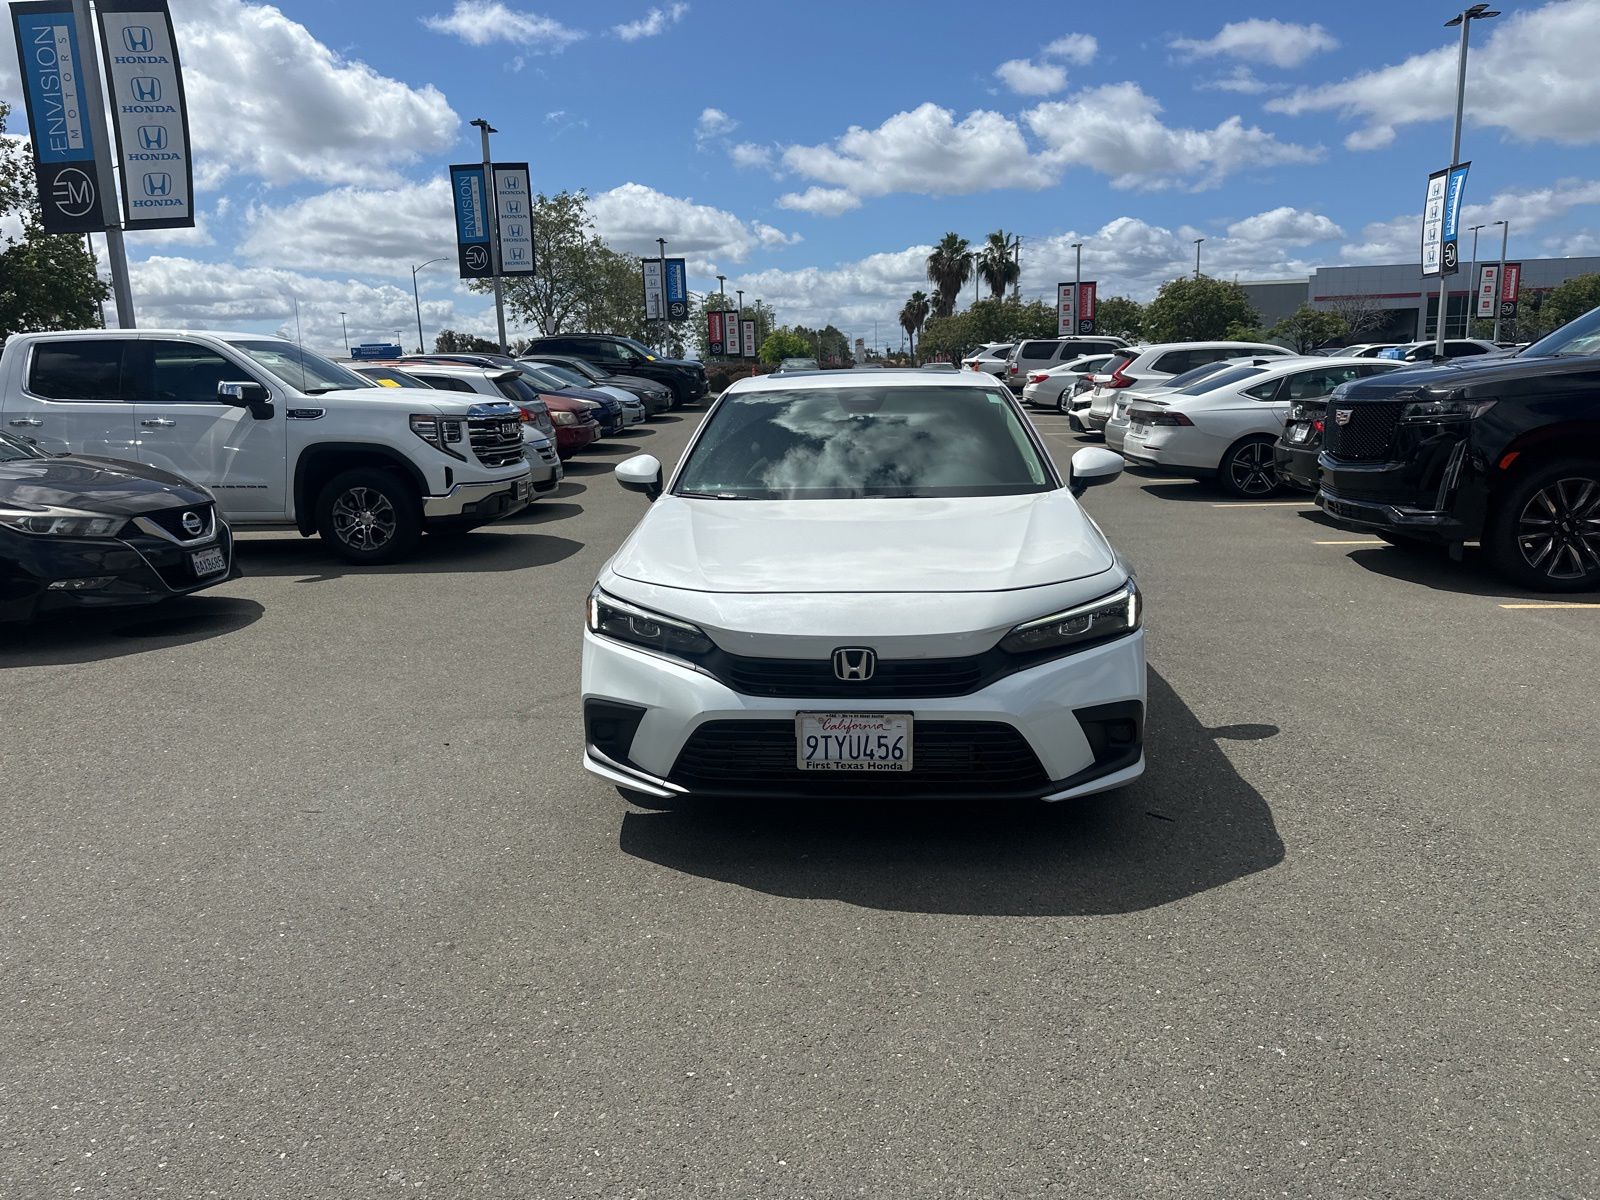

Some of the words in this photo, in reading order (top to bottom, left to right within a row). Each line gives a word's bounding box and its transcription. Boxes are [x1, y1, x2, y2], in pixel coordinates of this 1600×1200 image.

[114, 56, 169, 65] HONDA
[31, 26, 67, 151] ENVISION
[59, 37, 80, 139] MOTORS
[121, 105, 177, 114] HONDA
[128, 152, 182, 162] HONDA
[132, 198, 184, 208] HONDA
[459, 176, 476, 238] ENVISION
[1446, 176, 1459, 237] ENVISION
[1503, 268, 1512, 299] ENVISION
[822, 717, 891, 734] California
[805, 735, 904, 760] 9TYU456
[806, 761, 831, 770] First
[834, 761, 865, 770] Texas
[867, 761, 903, 770] Honda
